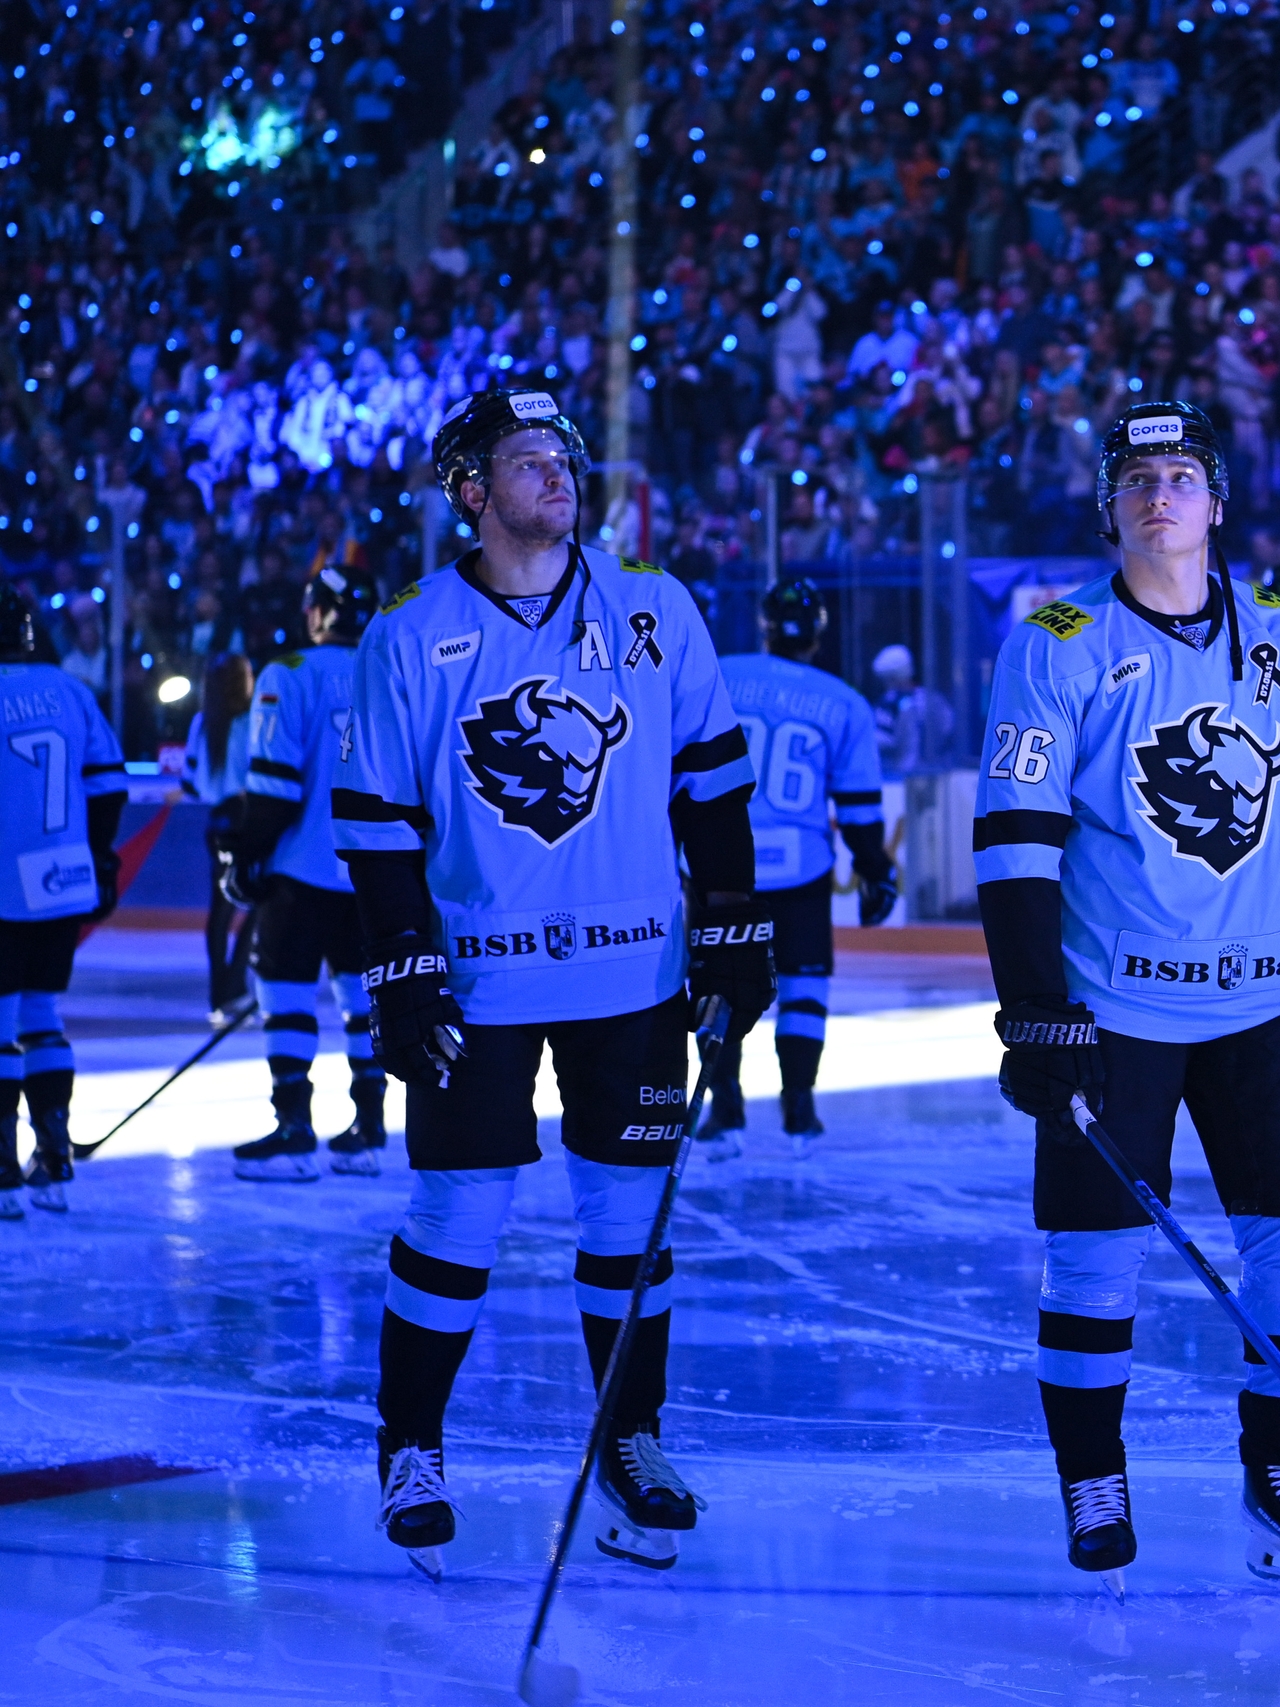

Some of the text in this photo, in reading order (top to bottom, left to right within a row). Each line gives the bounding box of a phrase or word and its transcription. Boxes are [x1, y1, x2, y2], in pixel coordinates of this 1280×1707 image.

[514, 399, 554, 412] согаз
[1131, 423, 1179, 437] согаз
[1030, 611, 1076, 636] LINE
[1049, 602, 1088, 623] MAX
[439, 641, 471, 658] МИР
[578, 619, 613, 671] A
[629, 629, 651, 663] 07.09.11
[1112, 662, 1141, 684] МИР
[1260, 661, 1274, 697] 07.09.11
[988, 722, 1056, 785] 26
[453, 917, 667, 959] BSB Bank
[1120, 953, 1210, 983] BSB
